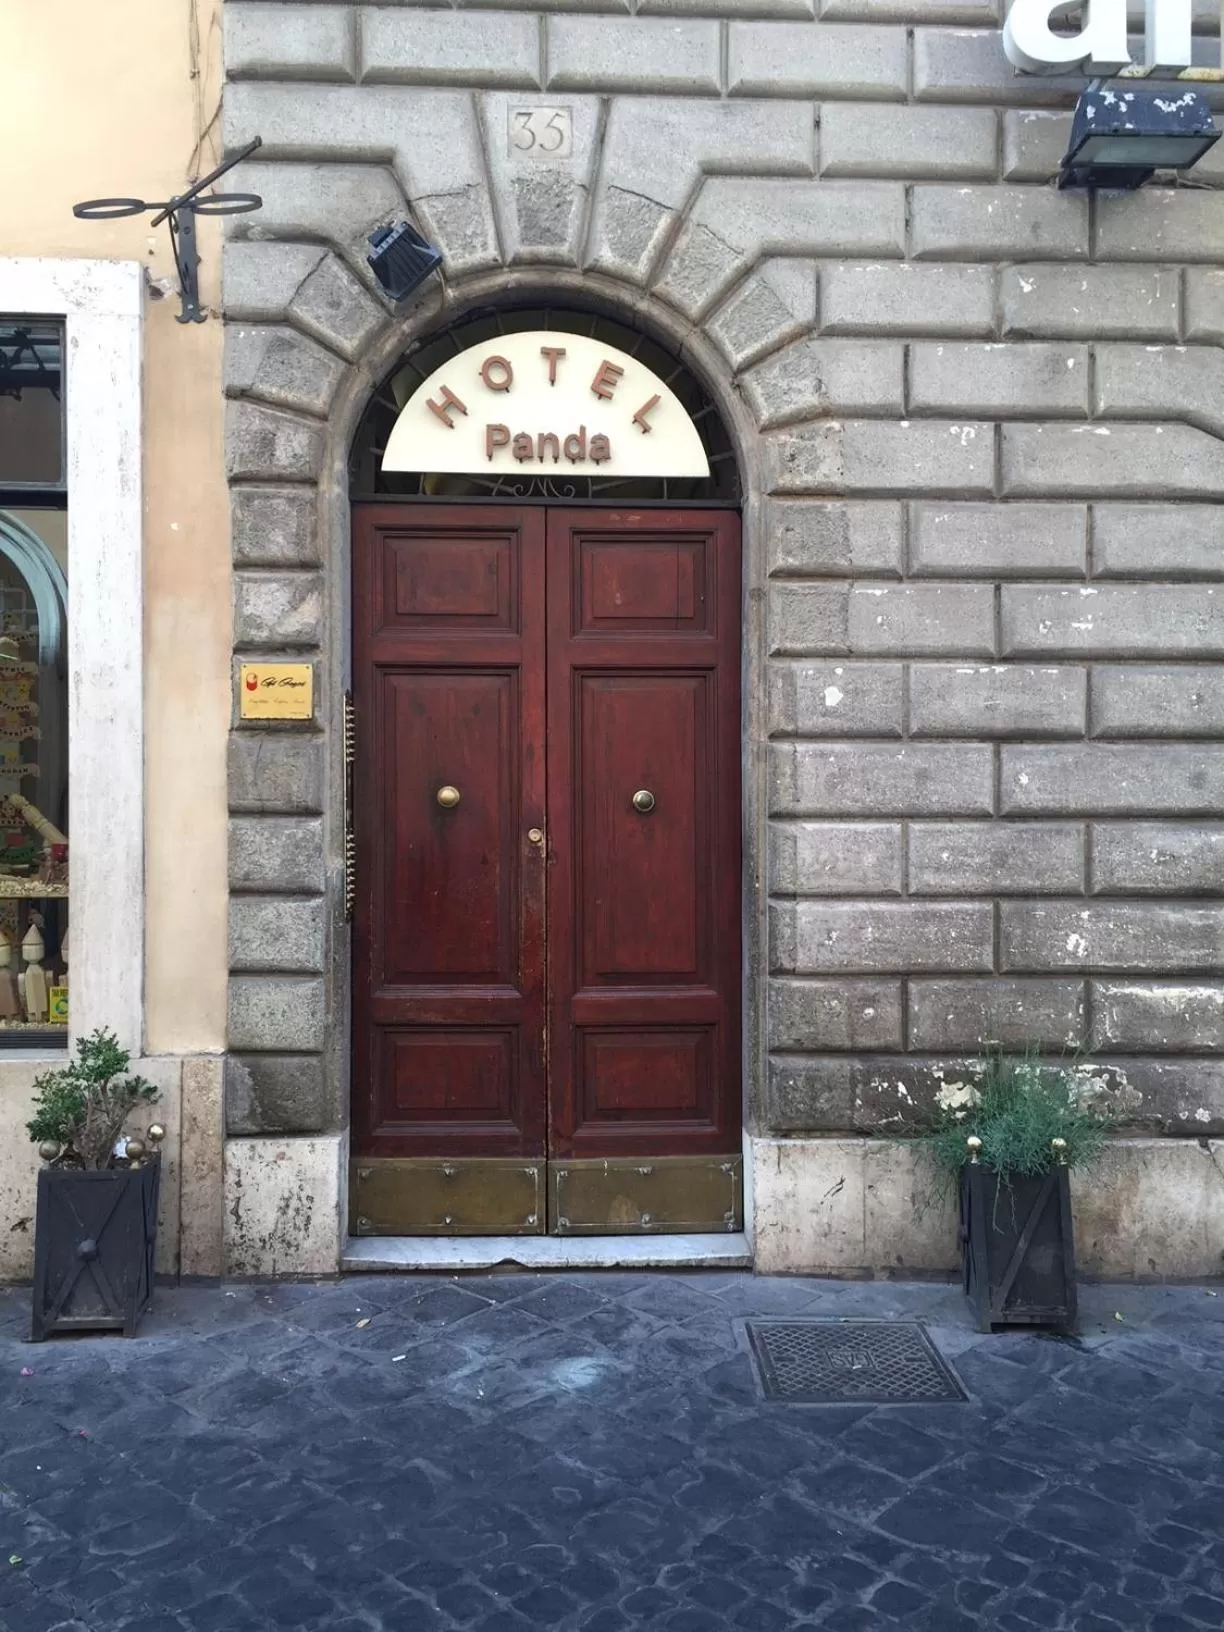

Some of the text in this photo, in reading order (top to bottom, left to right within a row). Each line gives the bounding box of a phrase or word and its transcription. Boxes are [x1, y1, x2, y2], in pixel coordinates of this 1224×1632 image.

[514, 112, 565, 152] 35
[426, 346, 662, 434] HOTEL
[486, 423, 611, 464] Panda
